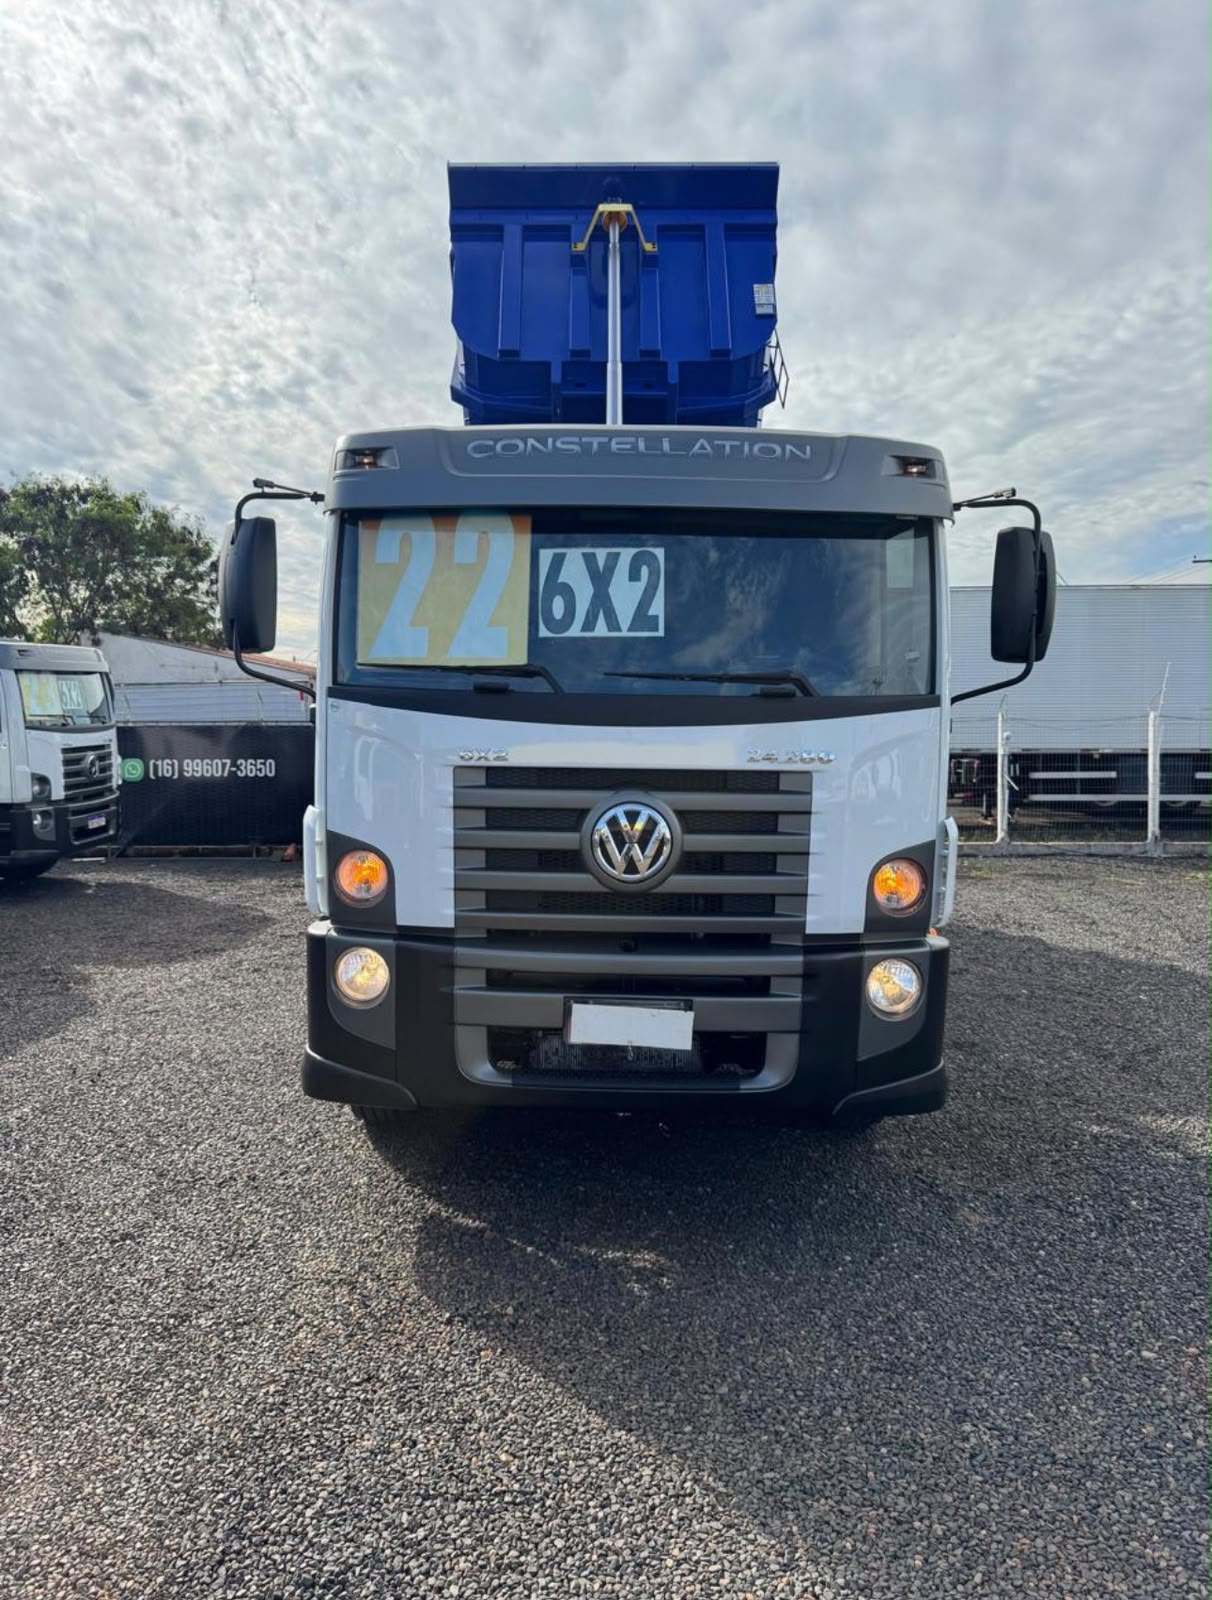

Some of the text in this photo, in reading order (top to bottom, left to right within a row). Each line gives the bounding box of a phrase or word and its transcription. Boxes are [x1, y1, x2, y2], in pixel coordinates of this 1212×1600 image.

[466, 436, 812, 461] CONSTELLATION
[367, 509, 515, 659] 22
[539, 549, 662, 635] 6X2
[148, 758, 276, 779] (16) 99607-3650
[592, 803, 672, 882] VW
